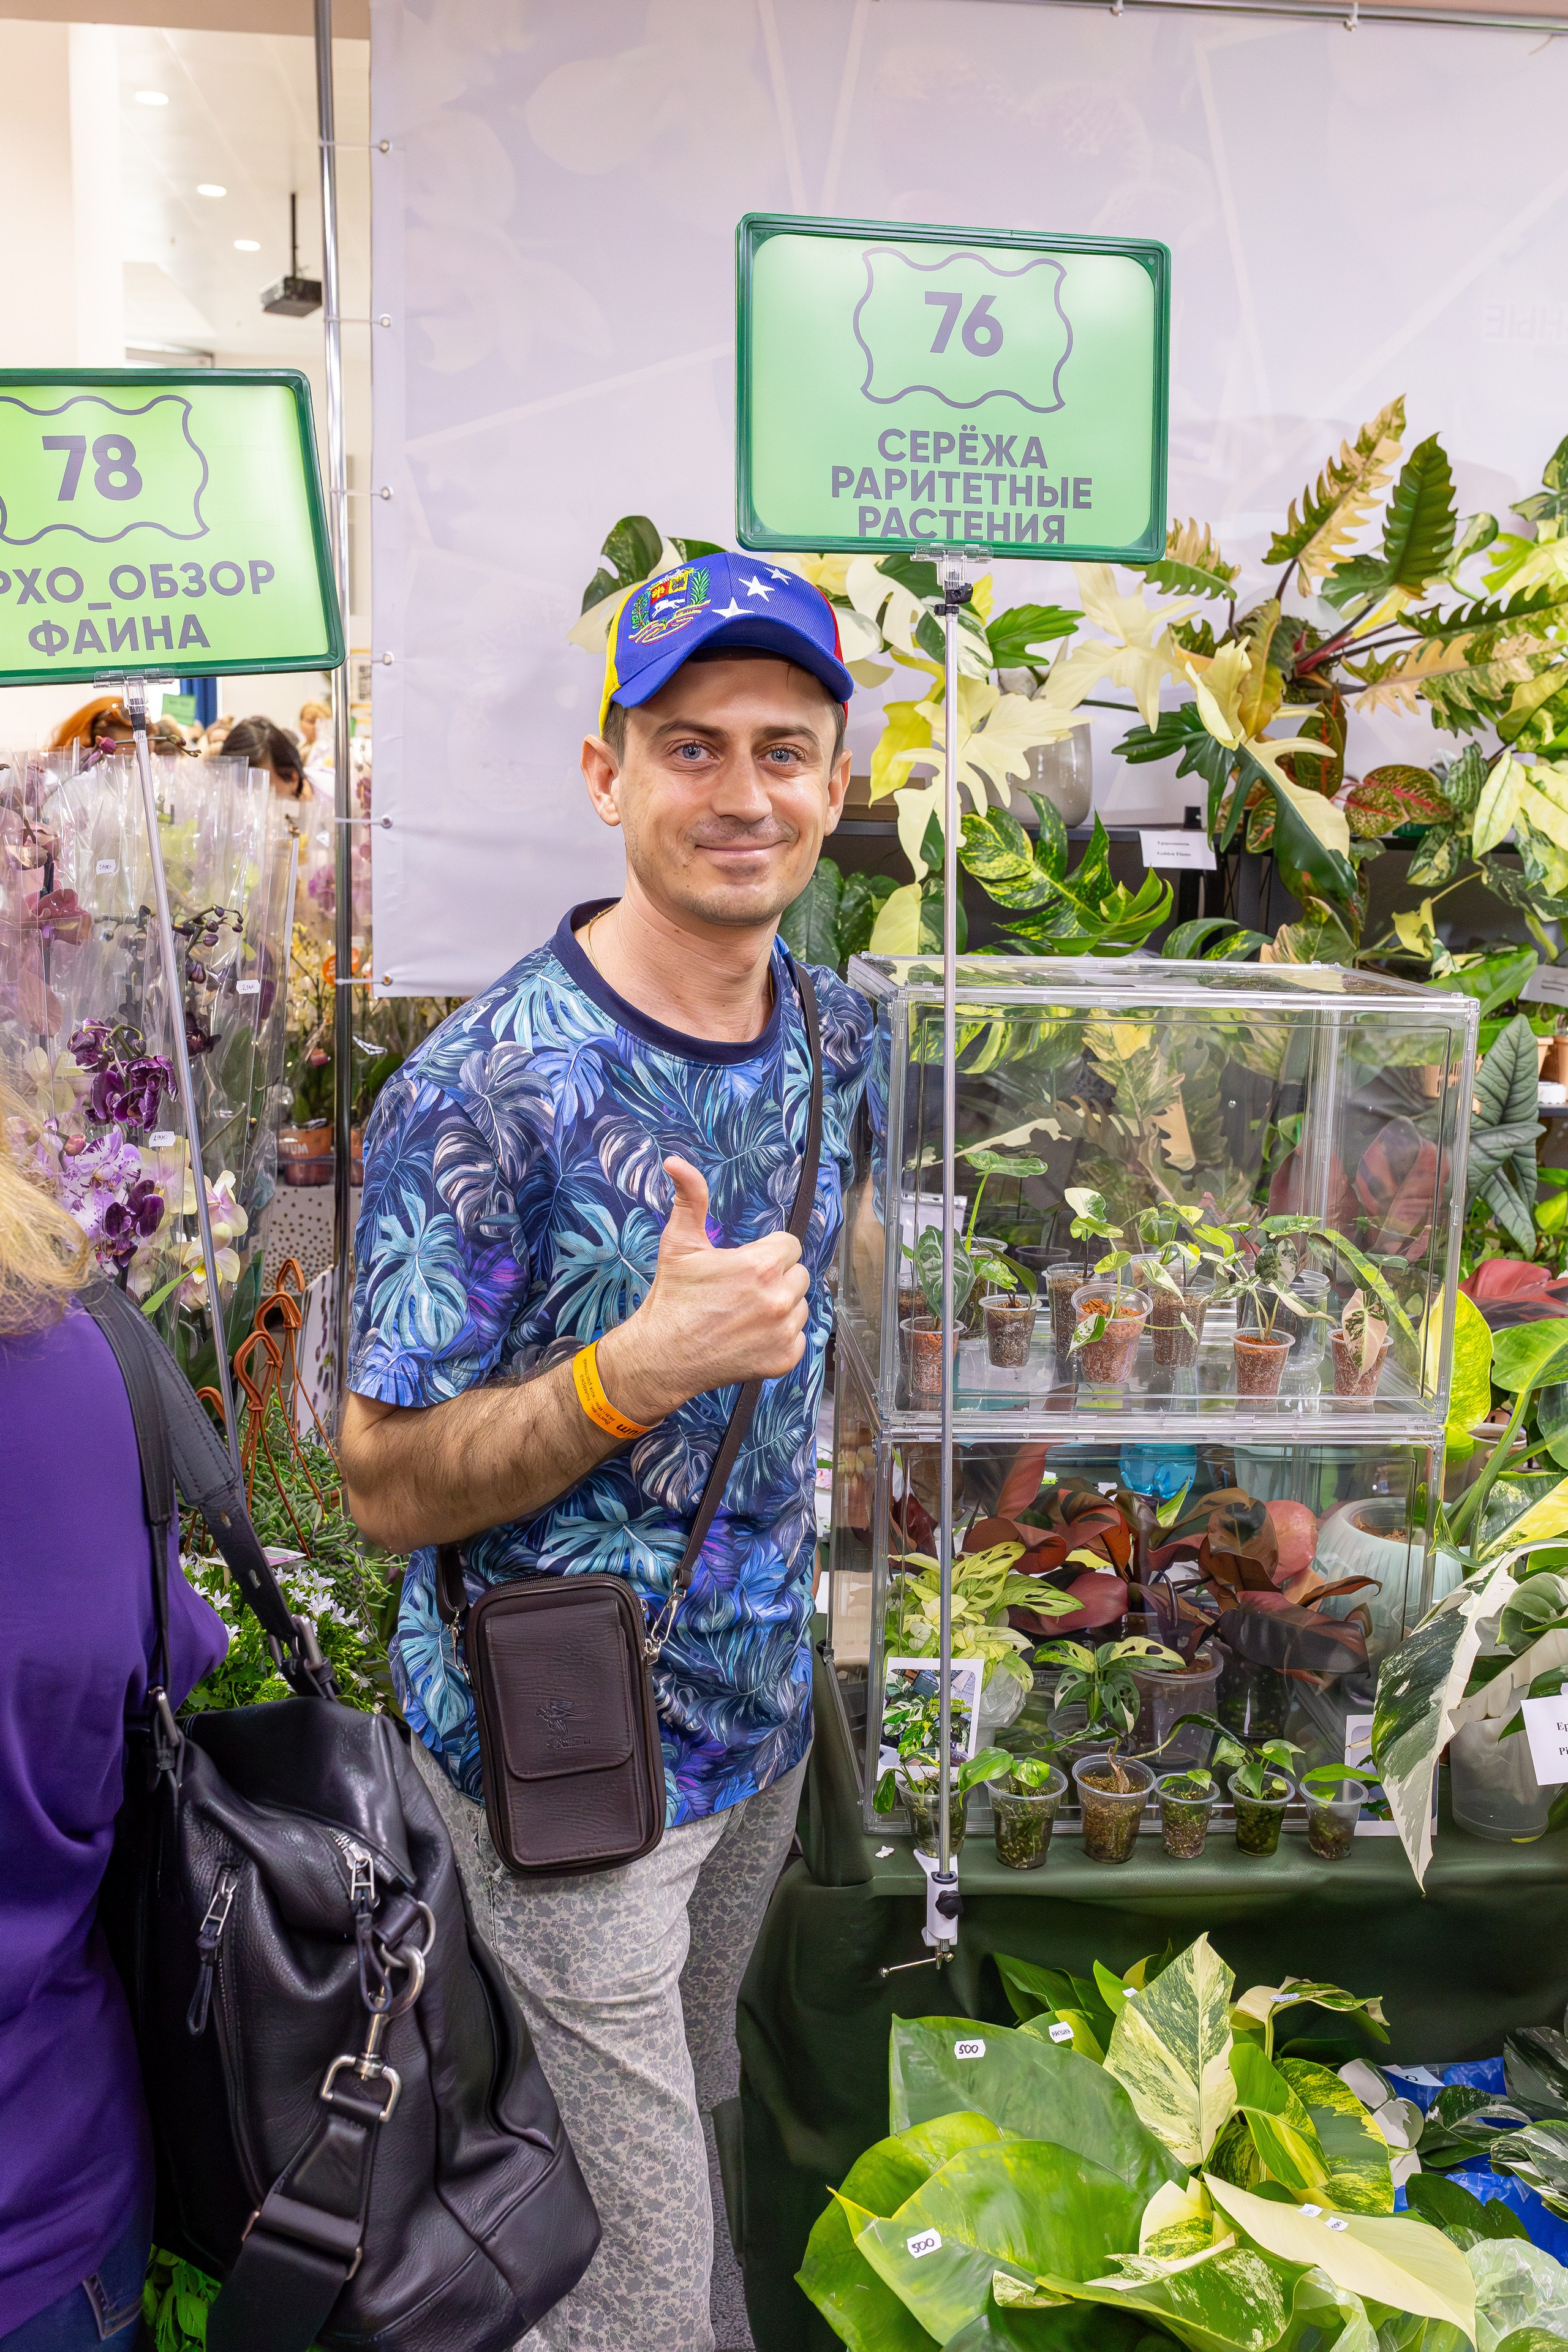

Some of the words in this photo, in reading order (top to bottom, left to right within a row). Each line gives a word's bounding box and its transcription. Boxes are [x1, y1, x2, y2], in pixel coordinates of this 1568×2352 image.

[924, 290, 1003, 357] 76
[42, 434, 143, 501] 78
[878, 424, 1048, 469] СЕРЁЖА
[832, 466, 1093, 510] РАРИТЕТНЫЕ
[859, 506, 1065, 544] РАСТЕНИЯ
[28, 614, 211, 657] ФАИНА
[959, 2044, 979, 2054] 500
[911, 2237, 935, 2253] 500
